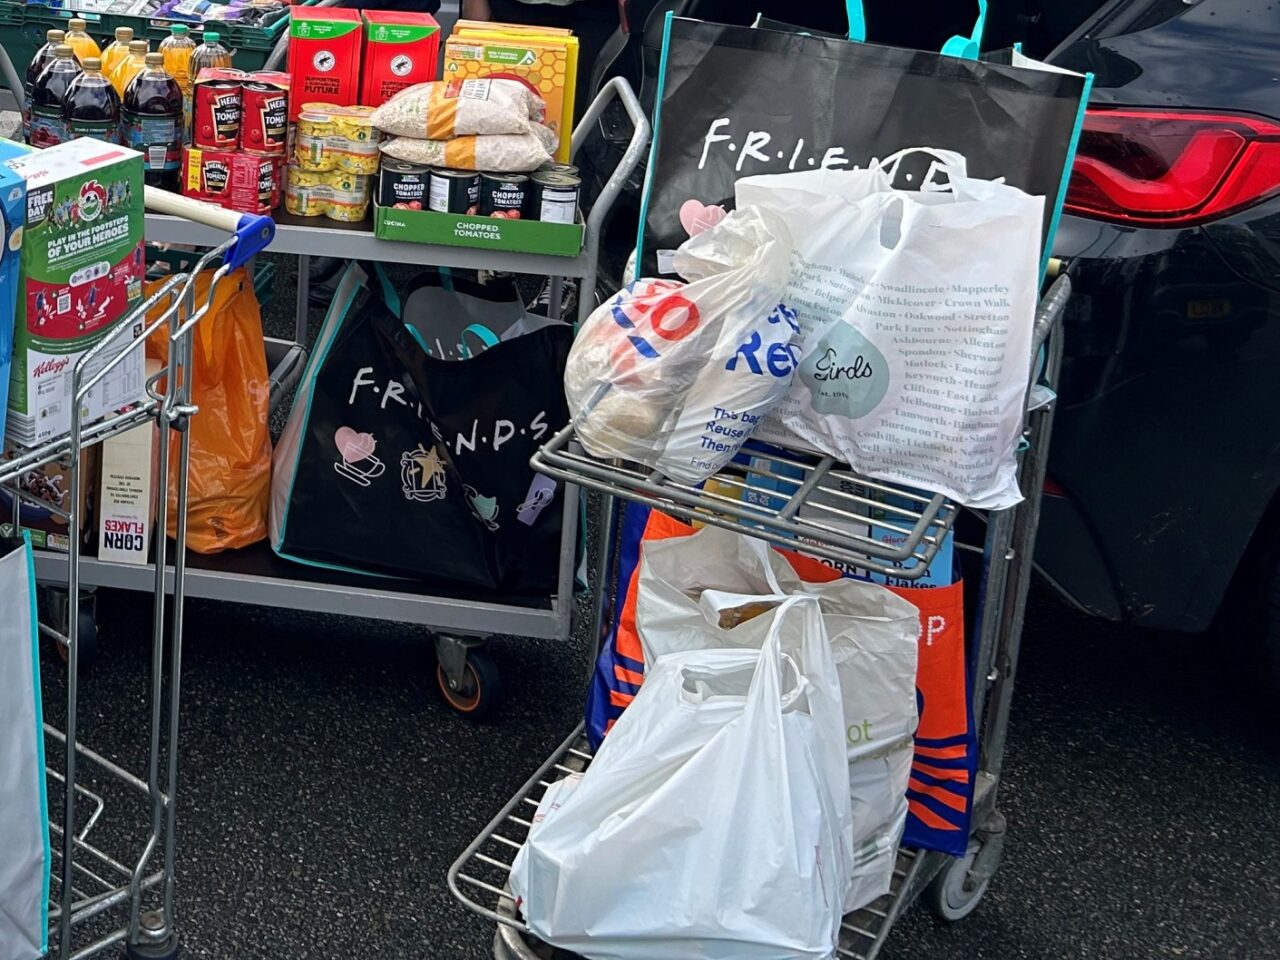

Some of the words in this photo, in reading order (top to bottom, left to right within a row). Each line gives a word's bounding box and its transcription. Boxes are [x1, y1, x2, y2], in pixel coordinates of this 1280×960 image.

[304, 86, 340, 95] FUTURE
[206, 172, 226, 180] TOMATO
[392, 182, 425, 192] CHOPPED
[27, 191, 55, 209] FREE
[491, 190, 525, 200] CHOPPED
[27, 205, 46, 219] DAY
[47, 235, 67, 249] PLAY
[68, 233, 76, 241] IN
[77, 228, 91, 240] THE
[91, 215, 129, 233] FOOTSTEPS
[456, 222, 500, 233] CHOPPED
[47, 245, 63, 259] OF
[63, 237, 92, 254] YOUR
[92, 223, 129, 244] HEROES
[453, 229, 502, 241] TOMATOES
[880, 282, 945, 294] Swadlincote
[950, 284, 1010, 296] Mapperley
[877, 295, 937, 307] Mickleover
[944, 298, 982, 308] Crown
[983, 298, 1011, 308] Walk
[904, 311, 956, 321] Oakwood
[963, 313, 1010, 321] Stretton
[875, 322, 902, 332] Park
[904, 324, 935, 332] Farm
[943, 325, 1009, 336] Nottingham
[892, 337, 952, 345] Ashbourne
[898, 348, 947, 358] Spondon
[953, 348, 1005, 363] Sherwood
[33, 355, 71, 379] Kellogg's
[904, 360, 948, 370] Matlock
[904, 372, 957, 386] Keyworth
[903, 383, 940, 396] Clifton
[946, 389, 970, 402] East
[900, 395, 957, 414] Melbourne
[963, 406, 1000, 417] Bulwell
[894, 407, 947, 426] Tamworth
[953, 420, 1000, 433] Bingham
[705, 421, 744, 438] Reuse
[880, 419, 917, 434] Burton
[918, 428, 932, 437] on
[933, 430, 964, 443] Trent
[857, 430, 901, 445] Coalville
[907, 437, 953, 455] Lichfield
[104, 519, 145, 535] FLAKES
[103, 531, 145, 552] CORN
